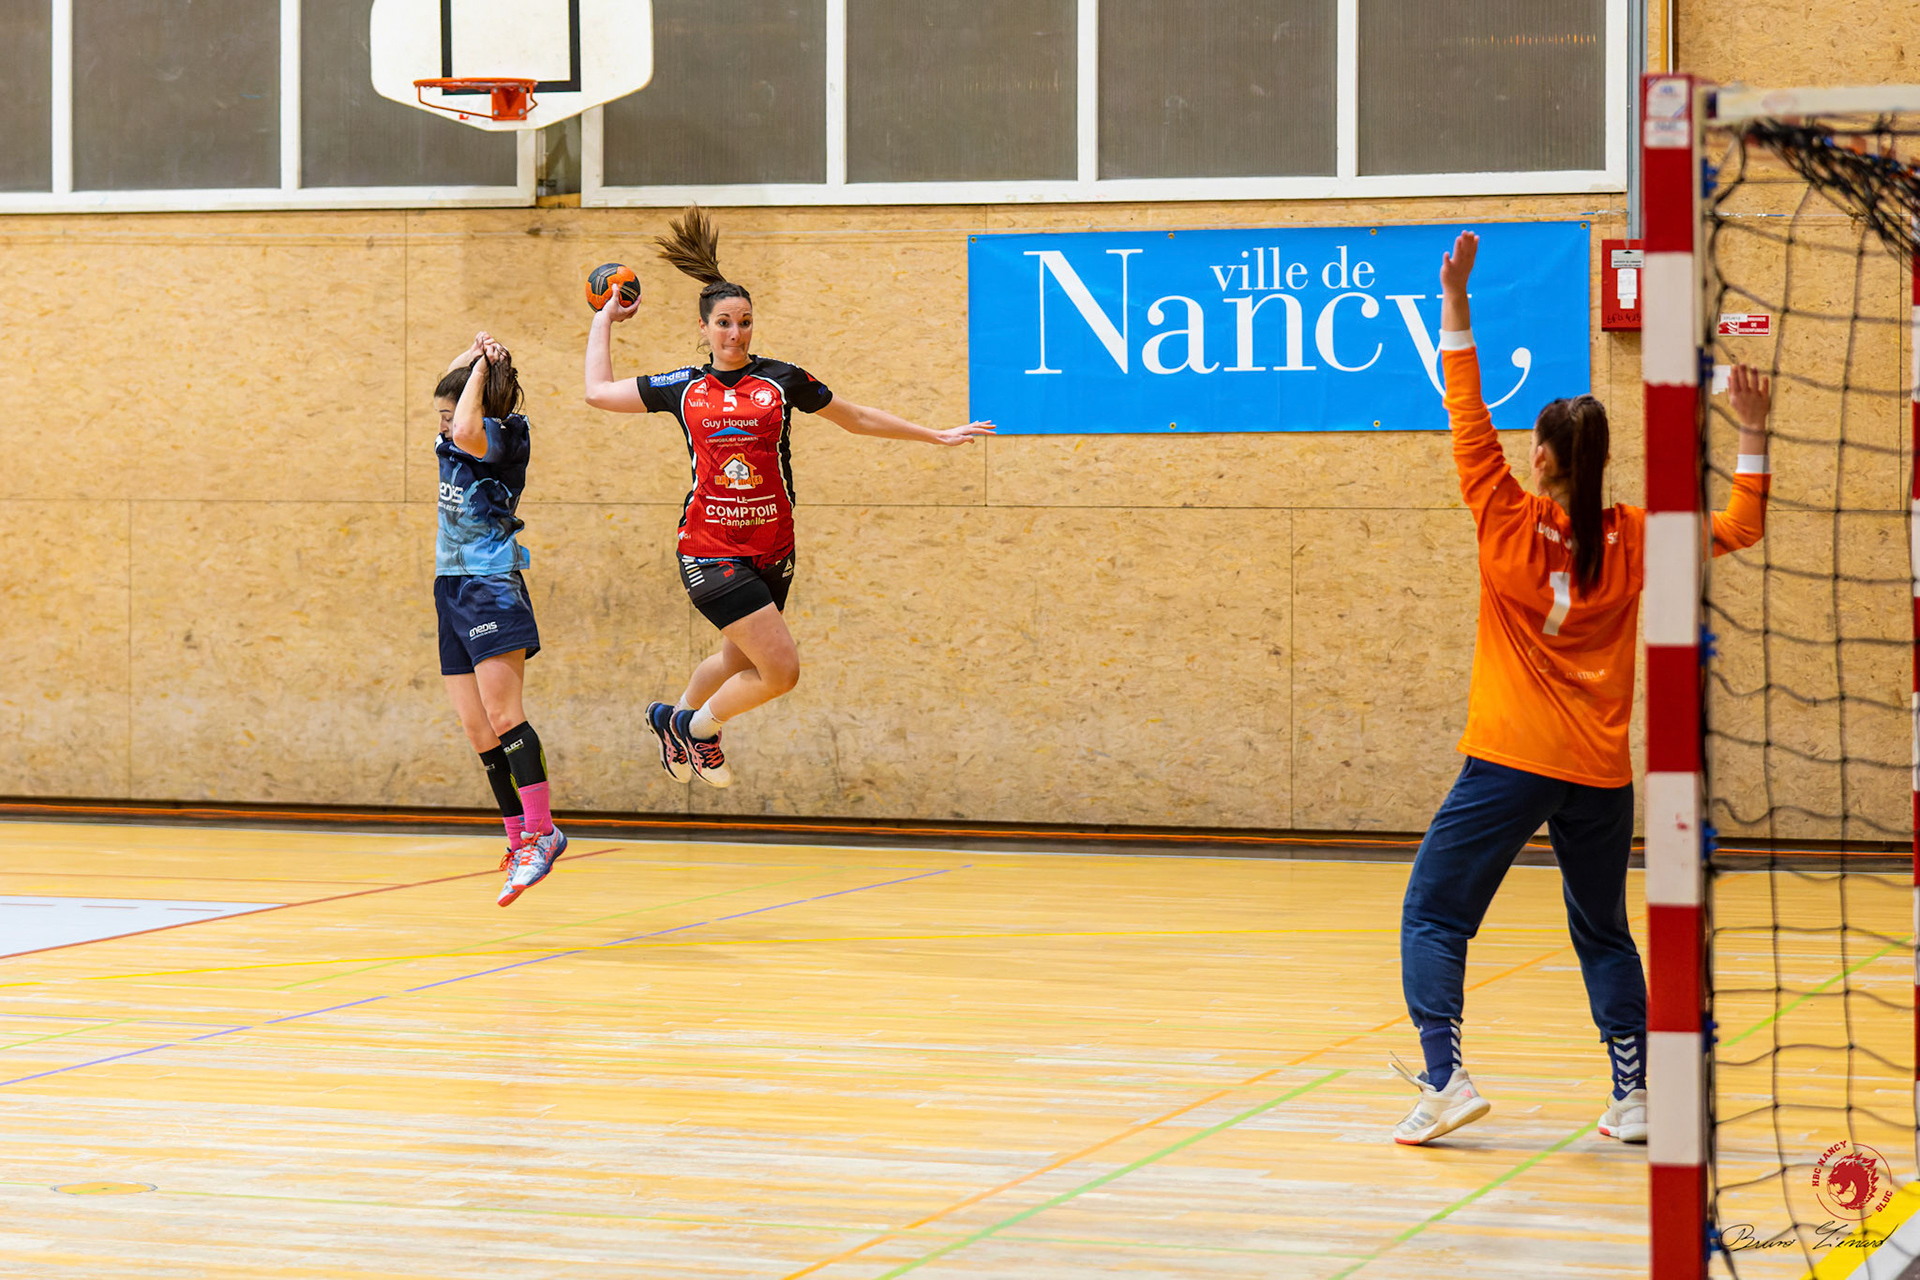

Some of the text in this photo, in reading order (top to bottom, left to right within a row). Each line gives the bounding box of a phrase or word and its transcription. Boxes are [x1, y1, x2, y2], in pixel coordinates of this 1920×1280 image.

[1210, 245, 1376, 292] ville de
[1023, 248, 1532, 410] Nancy
[722, 388, 738, 413] 5
[702, 418, 759, 429] Guy Hoquet
[736, 496, 748, 504] LE
[705, 503, 778, 518] COMPTOIR
[720, 517, 766, 528] Campanile
[1542, 571, 1572, 636] 1
